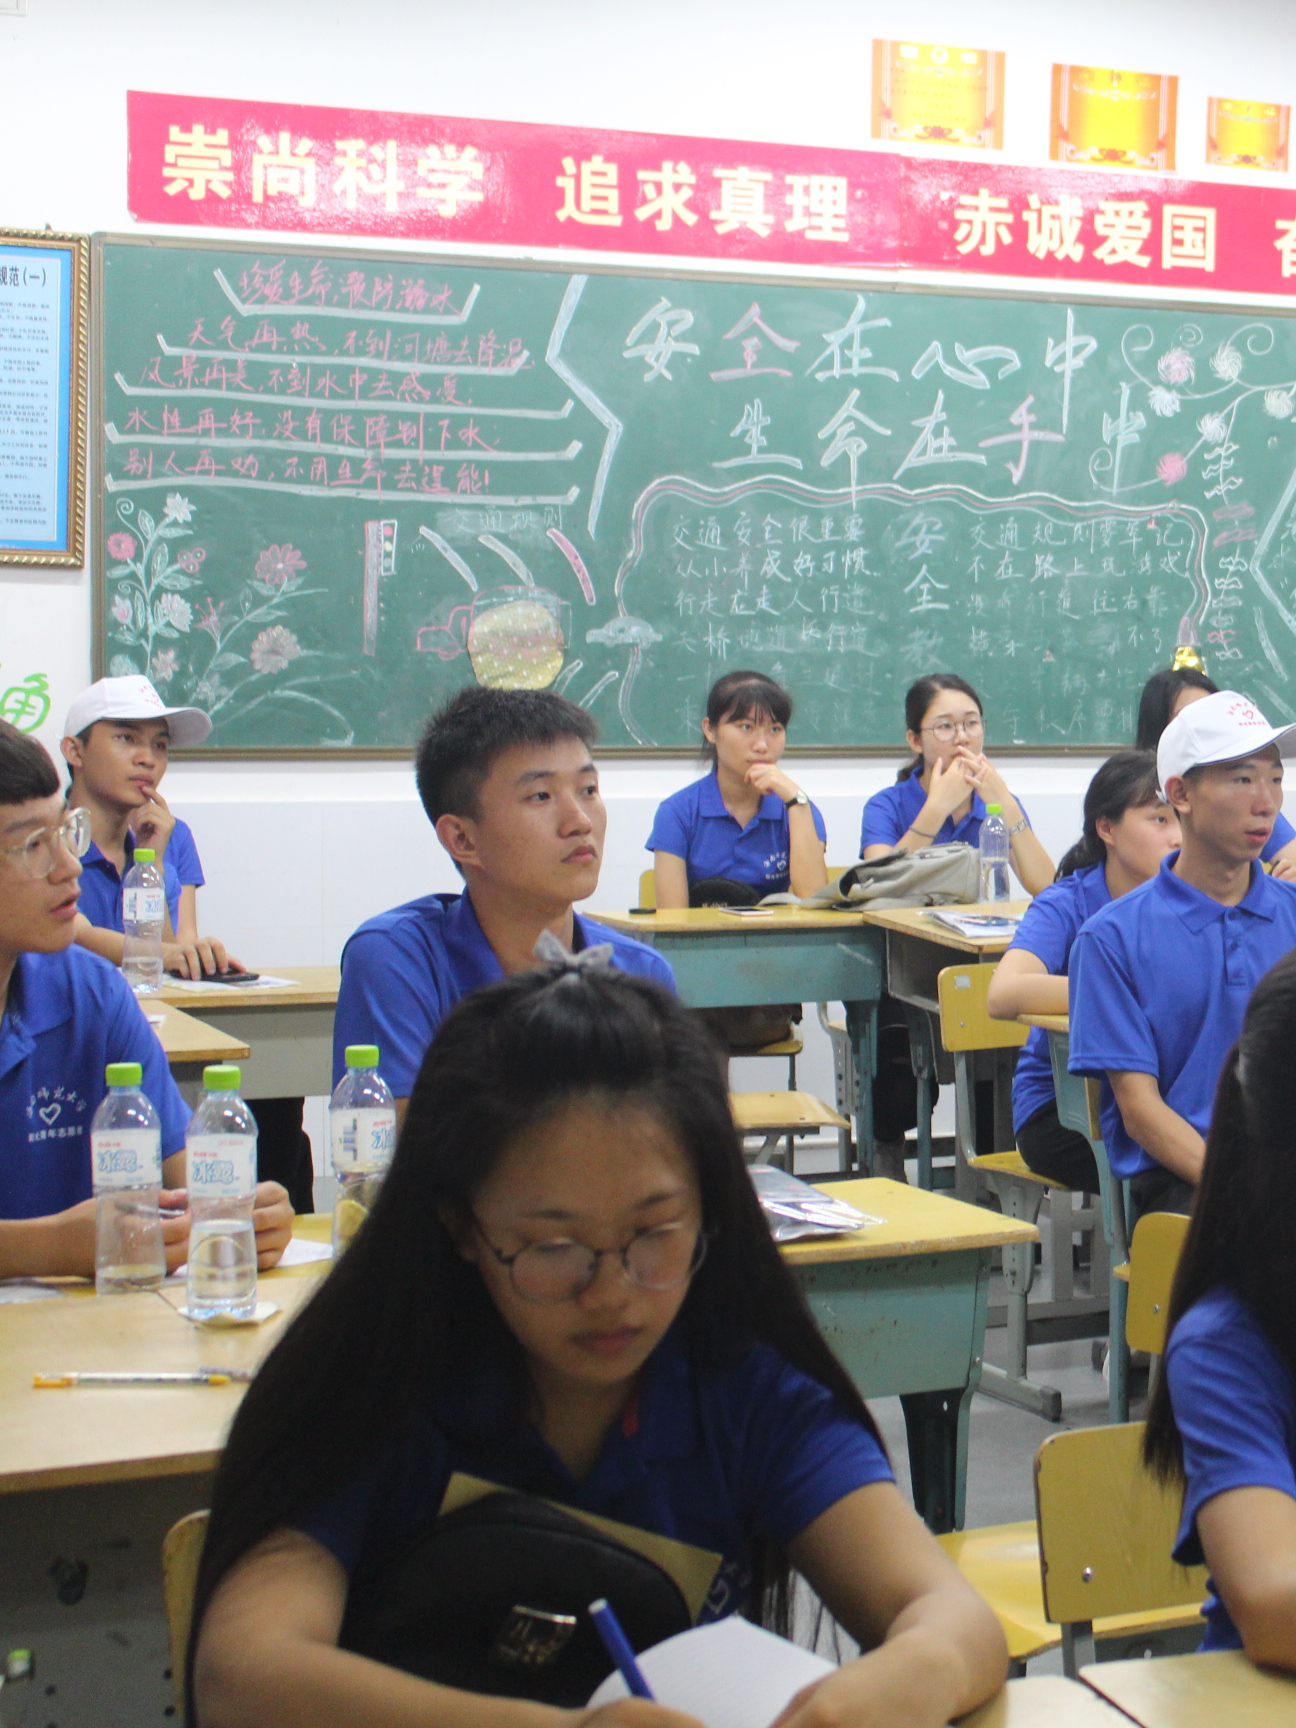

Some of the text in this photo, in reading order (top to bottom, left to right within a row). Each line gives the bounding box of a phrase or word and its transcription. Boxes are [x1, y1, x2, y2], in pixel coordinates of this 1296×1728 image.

[162, 123, 486, 217] 崇尚科学
[555, 156, 850, 243] 追求真理
[954, 187, 1217, 274] 赤诚爱国
[622, 293, 1098, 435] 安全在心中
[711, 380, 1147, 510] 生命在手中
[671, 511, 866, 551] 交通安全很重要
[968, 516, 1184, 554] 交通规则要牢记
[966, 549, 1190, 583] 不在路上玩游戏
[675, 581, 875, 618] 行走应走人行道
